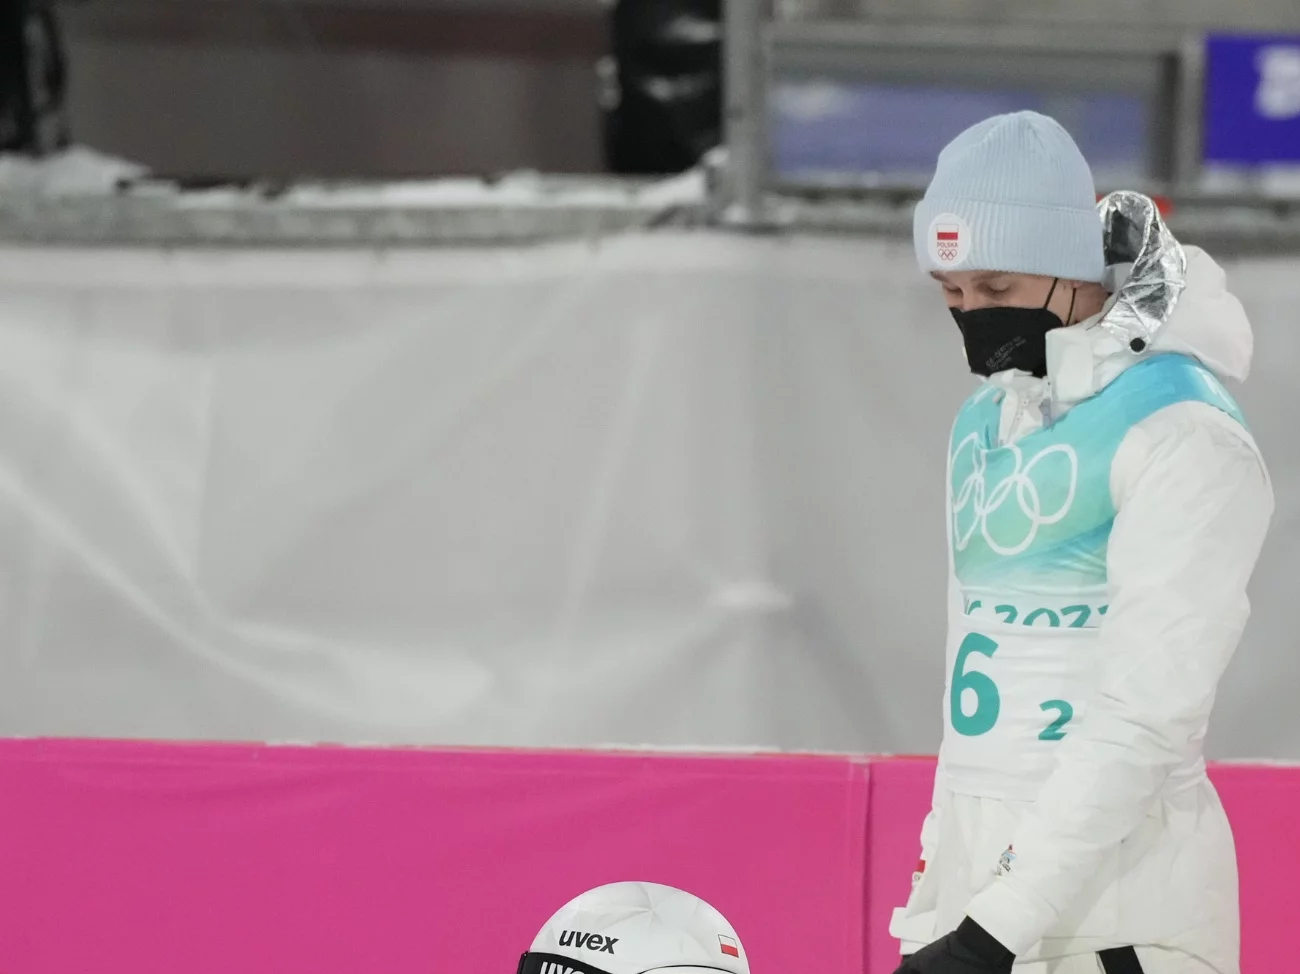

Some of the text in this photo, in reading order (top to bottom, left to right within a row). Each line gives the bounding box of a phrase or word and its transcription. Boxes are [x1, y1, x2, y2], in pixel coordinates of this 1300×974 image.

[950, 631, 1074, 740] 6 2
[558, 929, 619, 954] uvex
